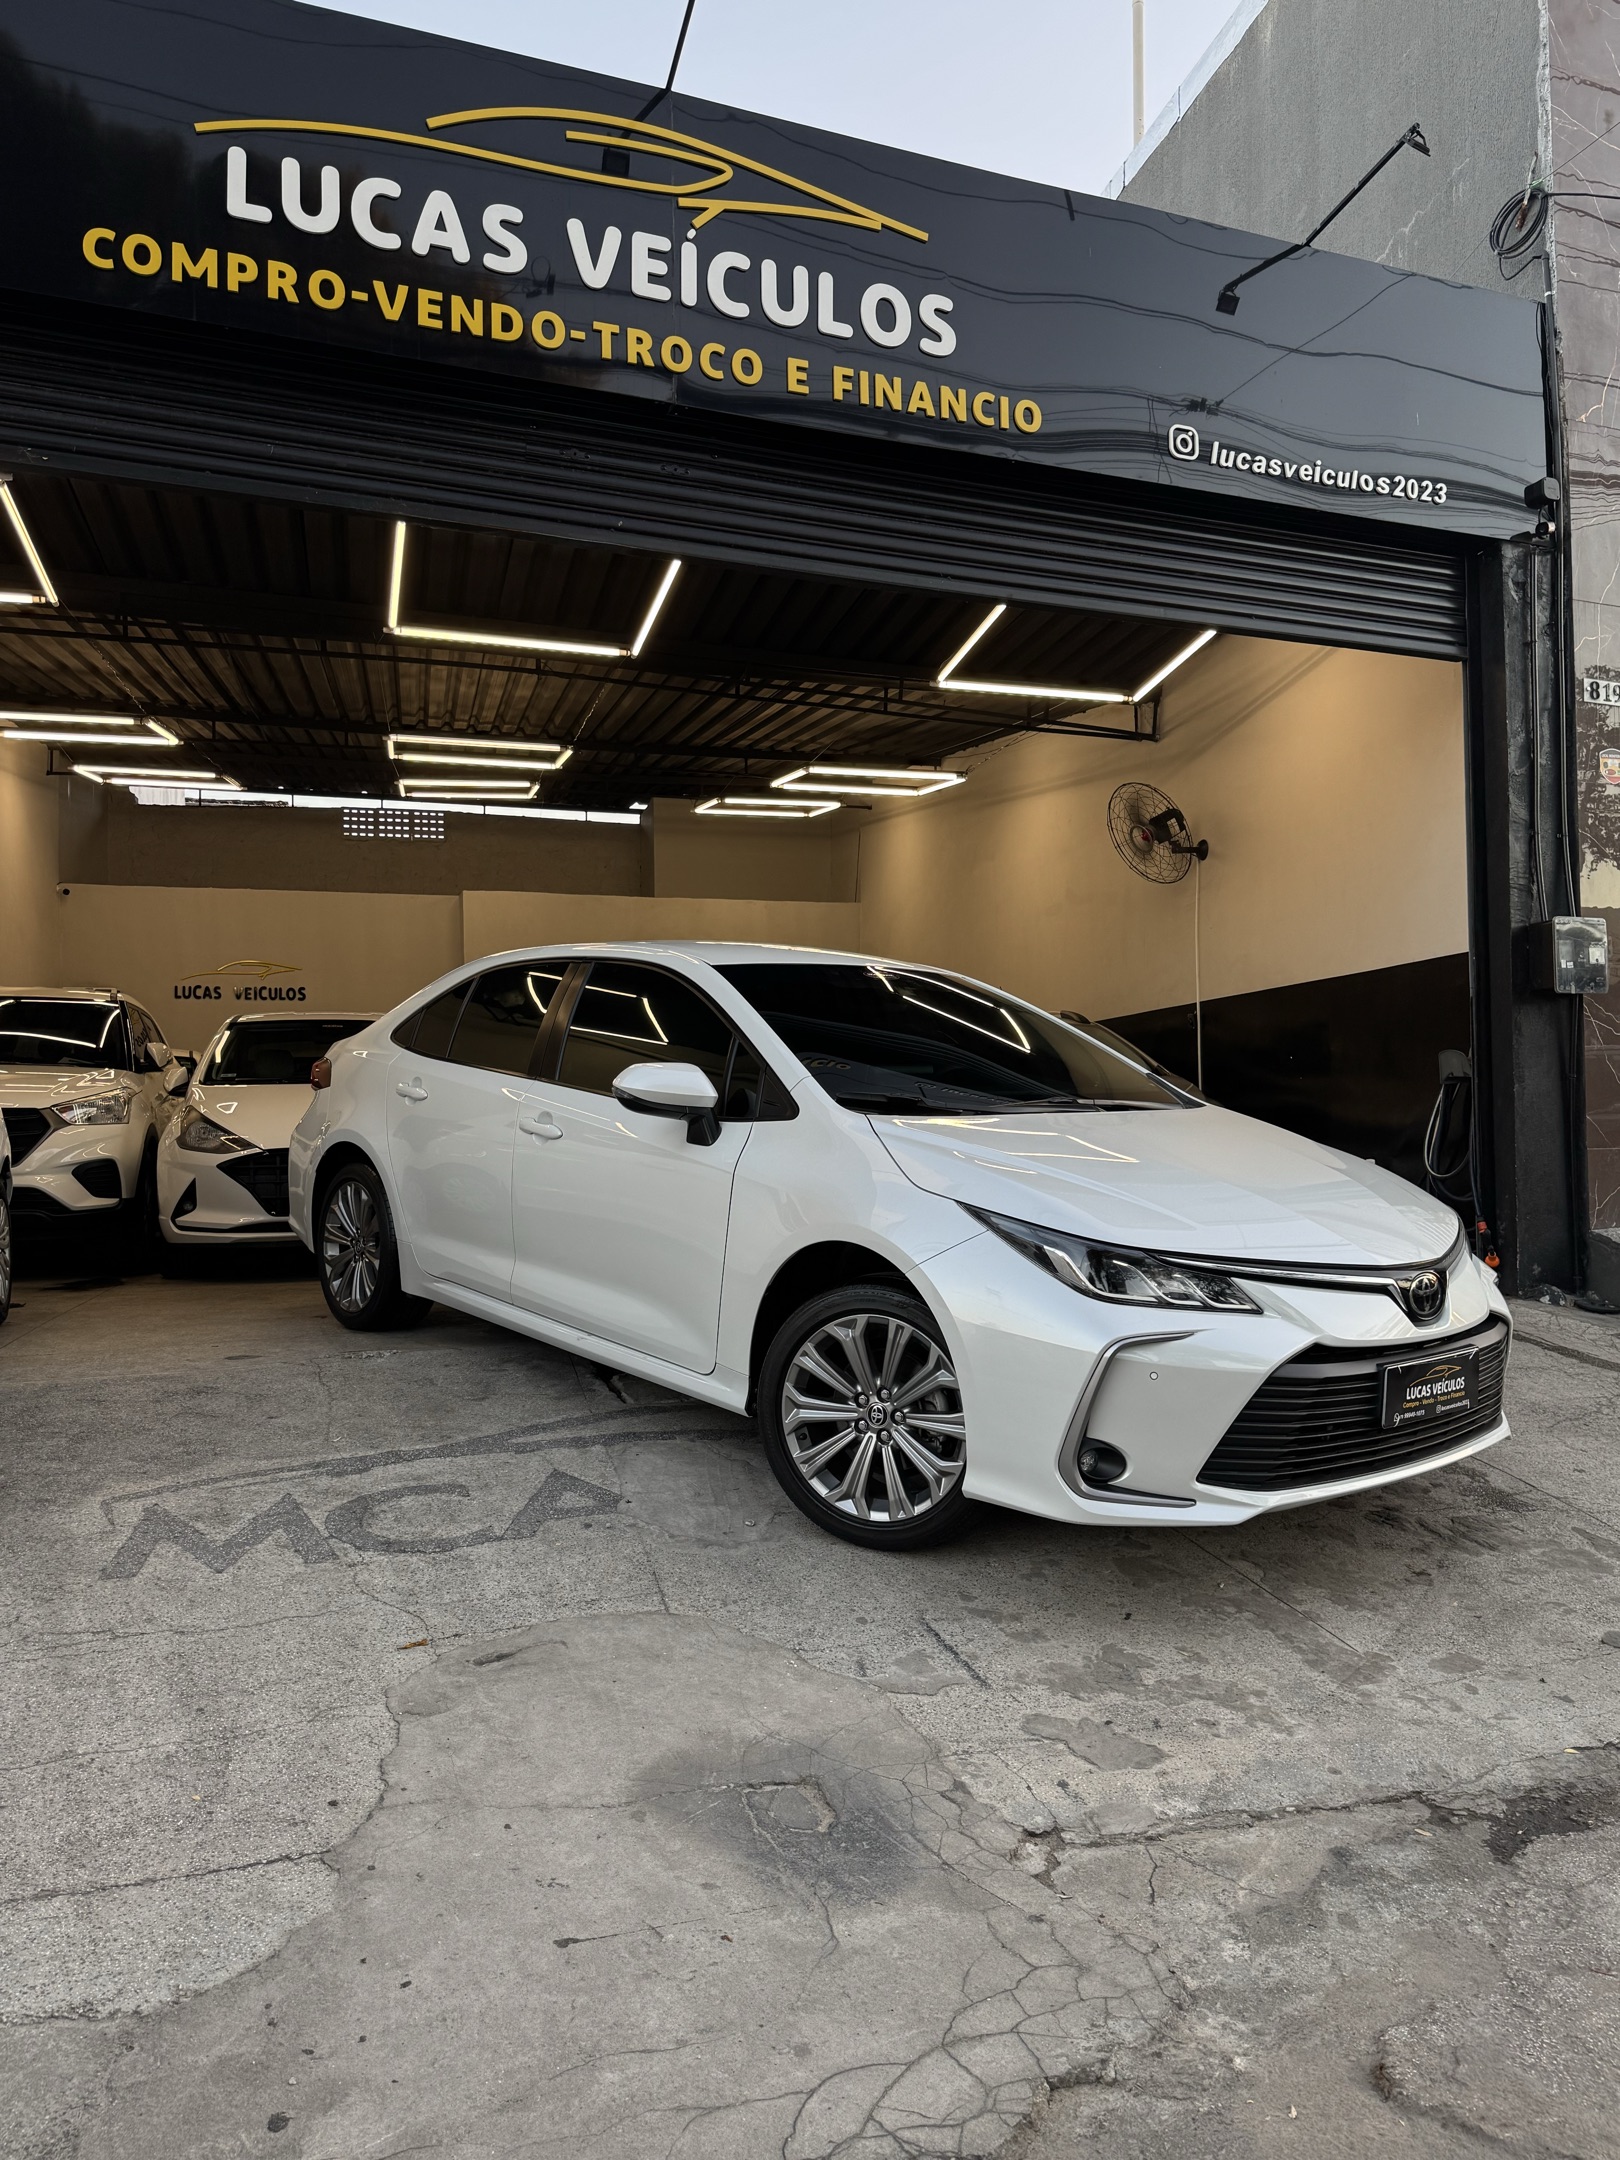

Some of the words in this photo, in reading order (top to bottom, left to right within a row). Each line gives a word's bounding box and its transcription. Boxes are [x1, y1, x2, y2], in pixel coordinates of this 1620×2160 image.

[226, 145, 528, 273] LUCAS
[566, 217, 957, 357] VEÍCULOS
[82, 226, 763, 386] COMPRO-VENDO-TROCO
[787, 355, 809, 395] E
[833, 364, 1043, 435] FINANCIO
[1210, 440, 1448, 505] lucasveiculos2023
[174, 985, 222, 1000] LUCAS
[233, 985, 307, 1002] VEICULOS
[1406, 1385, 1432, 1400] LUCAS
[1432, 1377, 1465, 1395] VEÍCULOS
